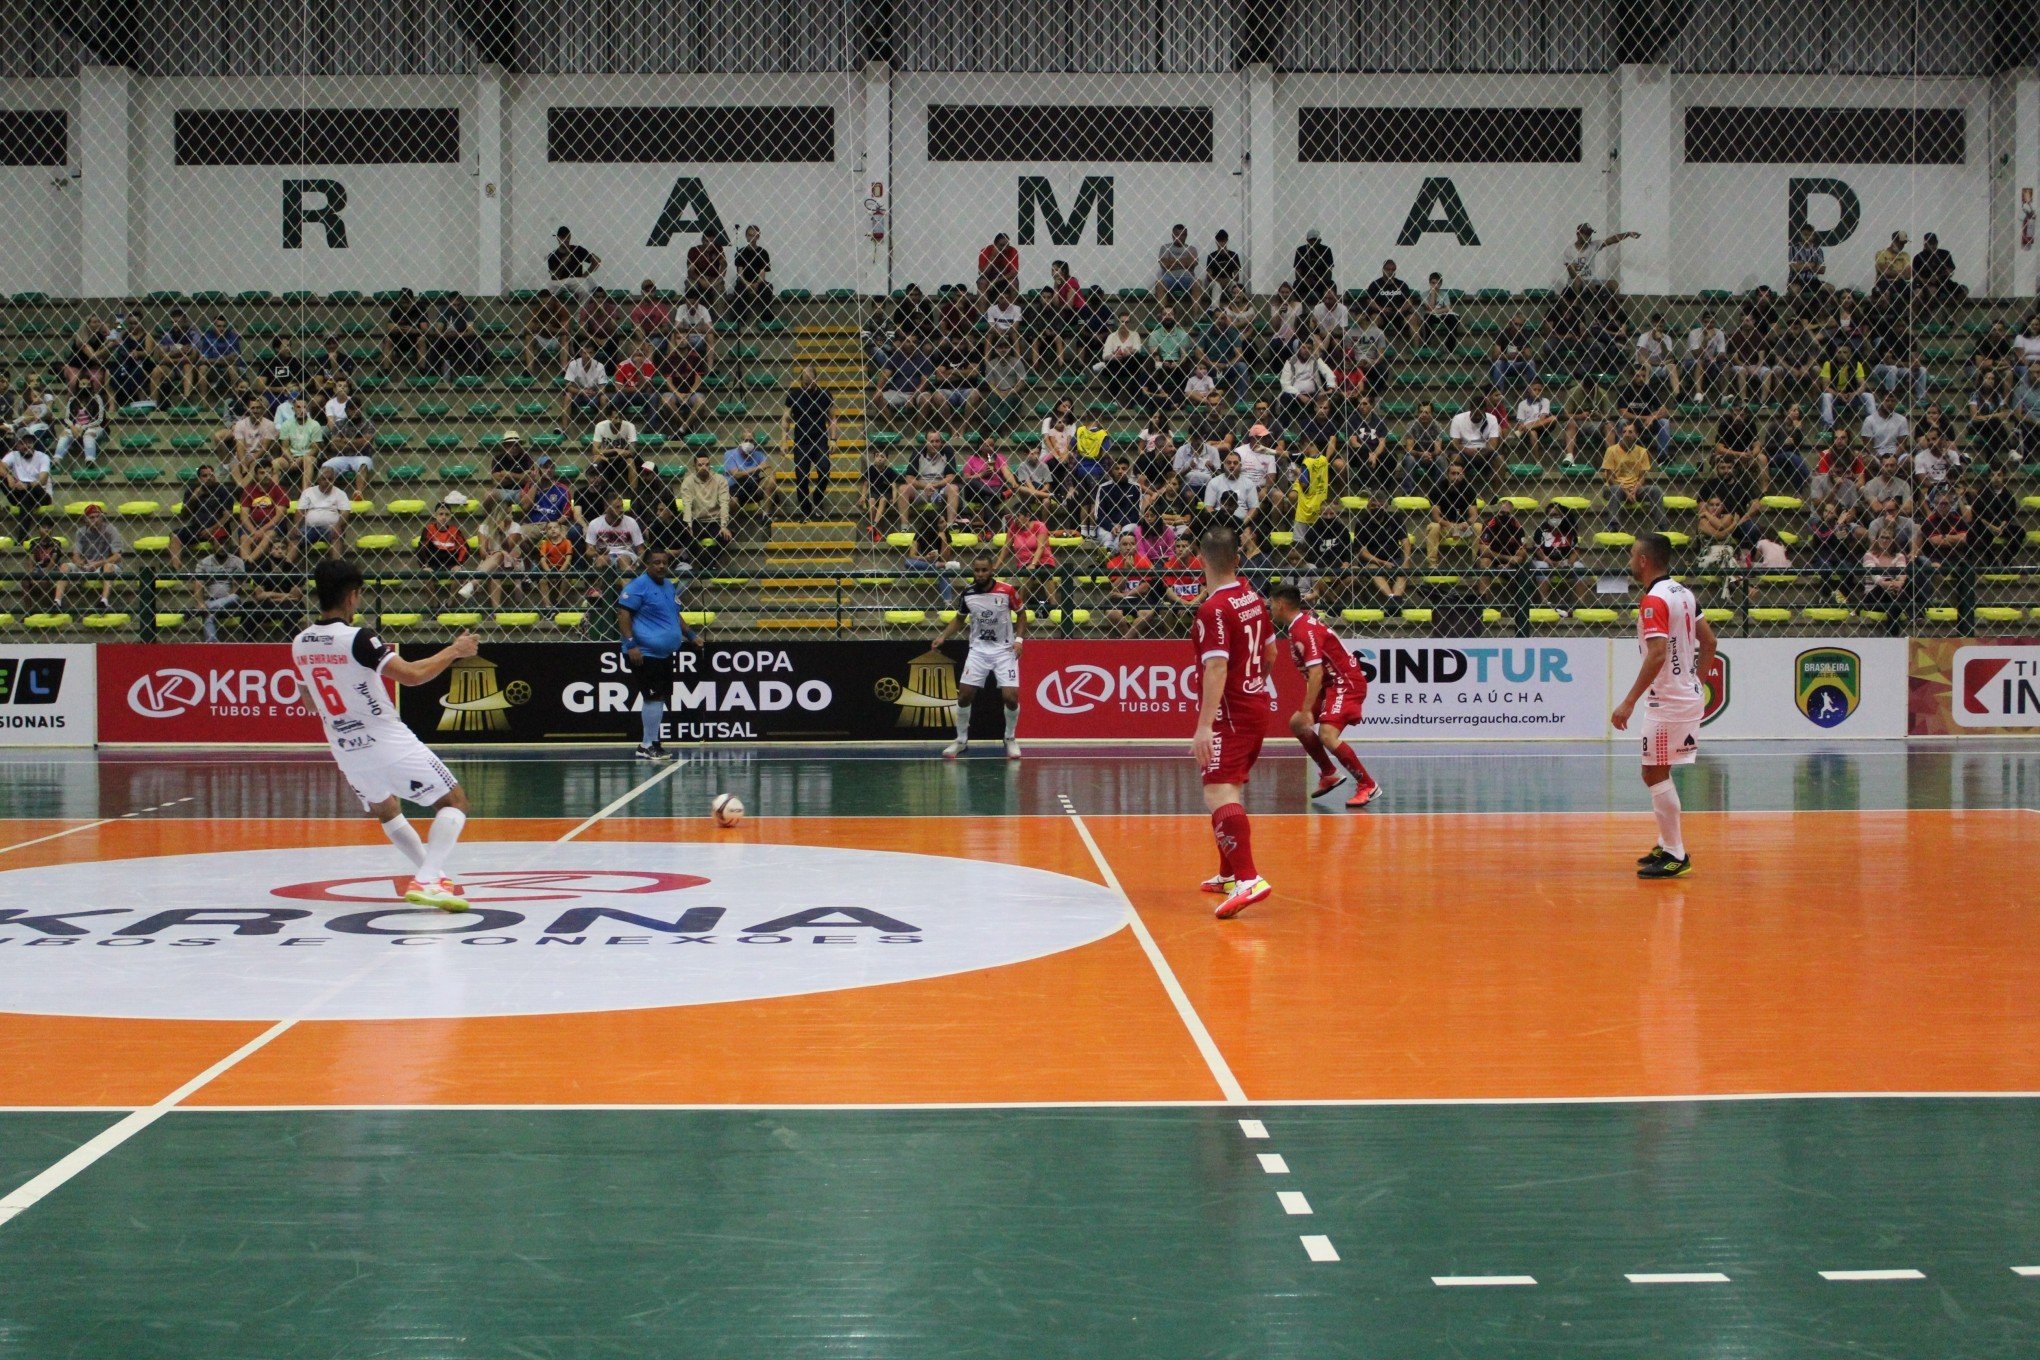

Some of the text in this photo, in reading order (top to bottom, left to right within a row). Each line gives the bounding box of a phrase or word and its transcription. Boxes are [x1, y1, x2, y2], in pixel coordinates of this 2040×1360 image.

[282, 179, 348, 249] R
[645, 176, 731, 247] A
[1017, 175, 1114, 246] M
[1395, 176, 1482, 246] A
[1244, 619, 1262, 677] 14
[711, 650, 794, 673] COPA
[1351, 647, 1574, 684] SINDTUR
[1804, 663, 1850, 672] BRASILEIRA
[1007, 669, 1016, 679] 13
[312, 667, 347, 717] 6
[1377, 689, 1544, 704] SERRA GAÚCHA
[210, 706, 261, 716] TUBOS
[269, 706, 277, 716] E
[1119, 702, 1170, 712] TUBOS
[1179, 702, 1187, 712] E
[677, 721, 758, 739] FUTSAL
[0, 906, 923, 936] KRONA
[279, 937, 333, 946] E
[391, 933, 924, 946] CONEXÕES
